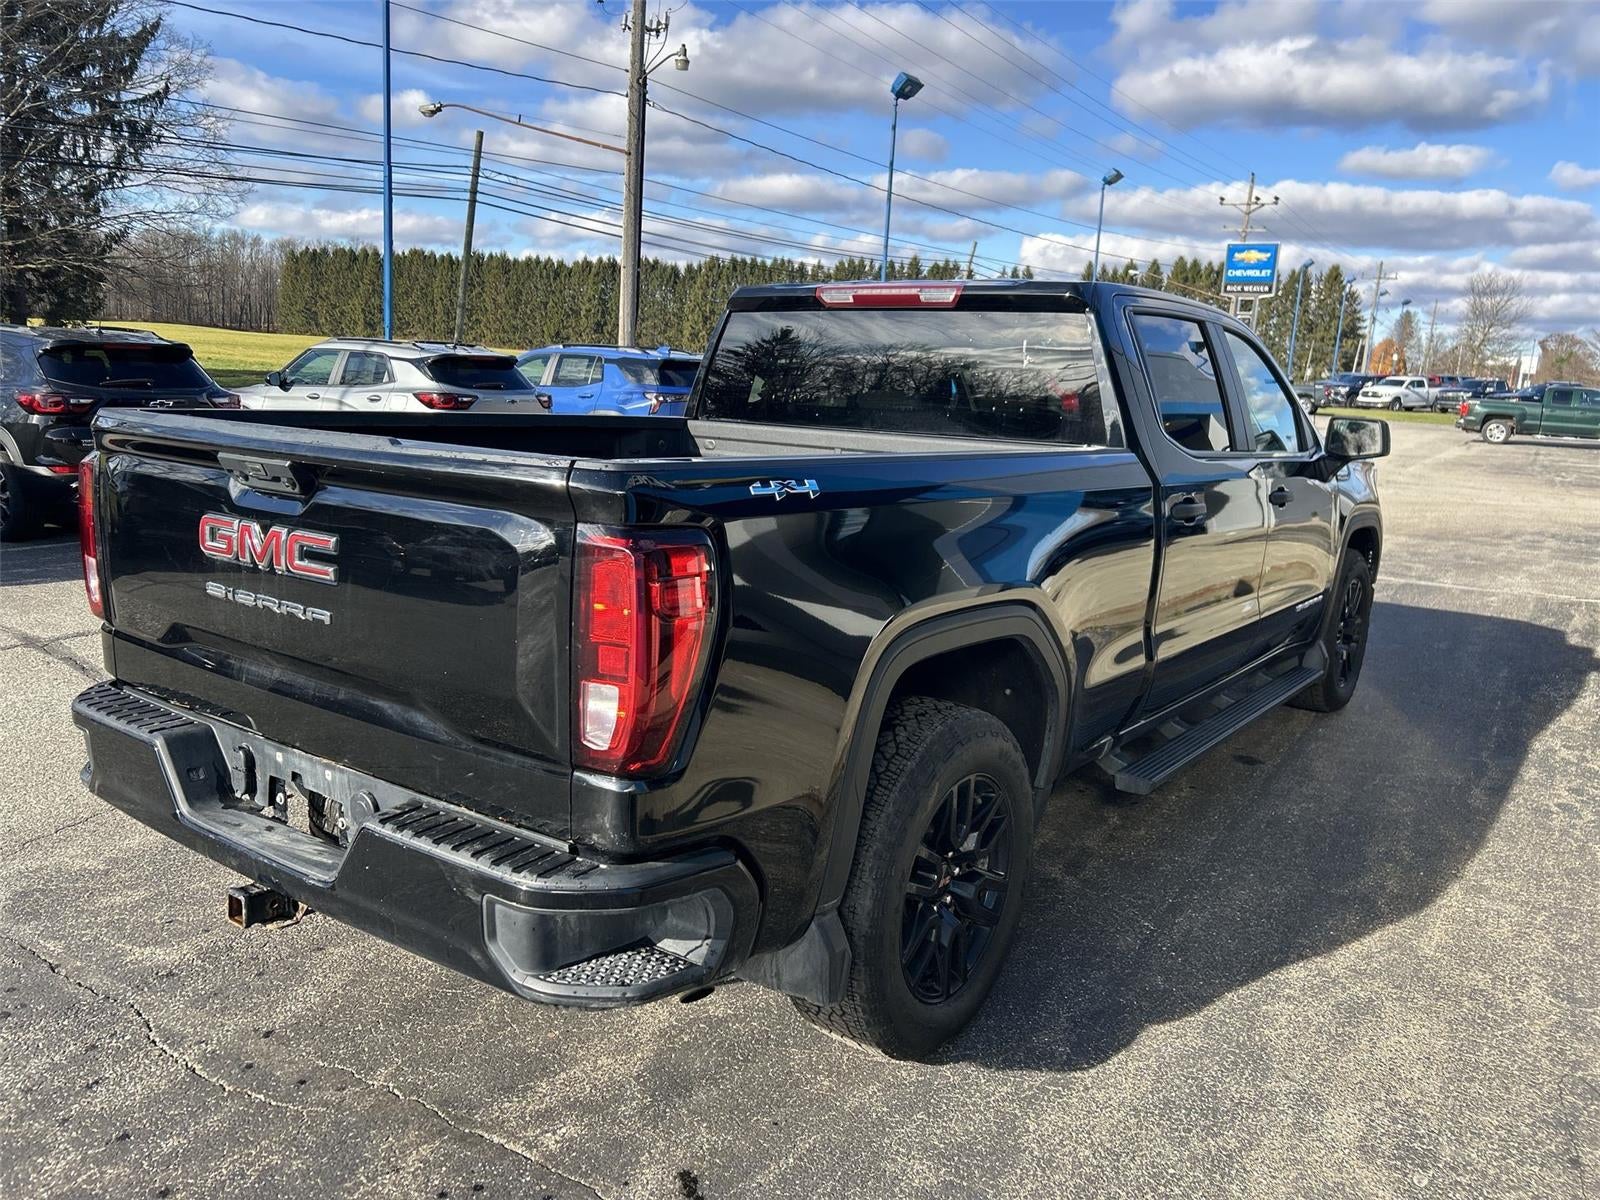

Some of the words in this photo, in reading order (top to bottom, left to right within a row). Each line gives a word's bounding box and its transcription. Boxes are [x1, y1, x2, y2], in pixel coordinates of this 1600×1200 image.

[1227, 269, 1272, 277] CHEVROLET
[199, 513, 339, 586] GMC
[206, 581, 331, 625] SIERRA
